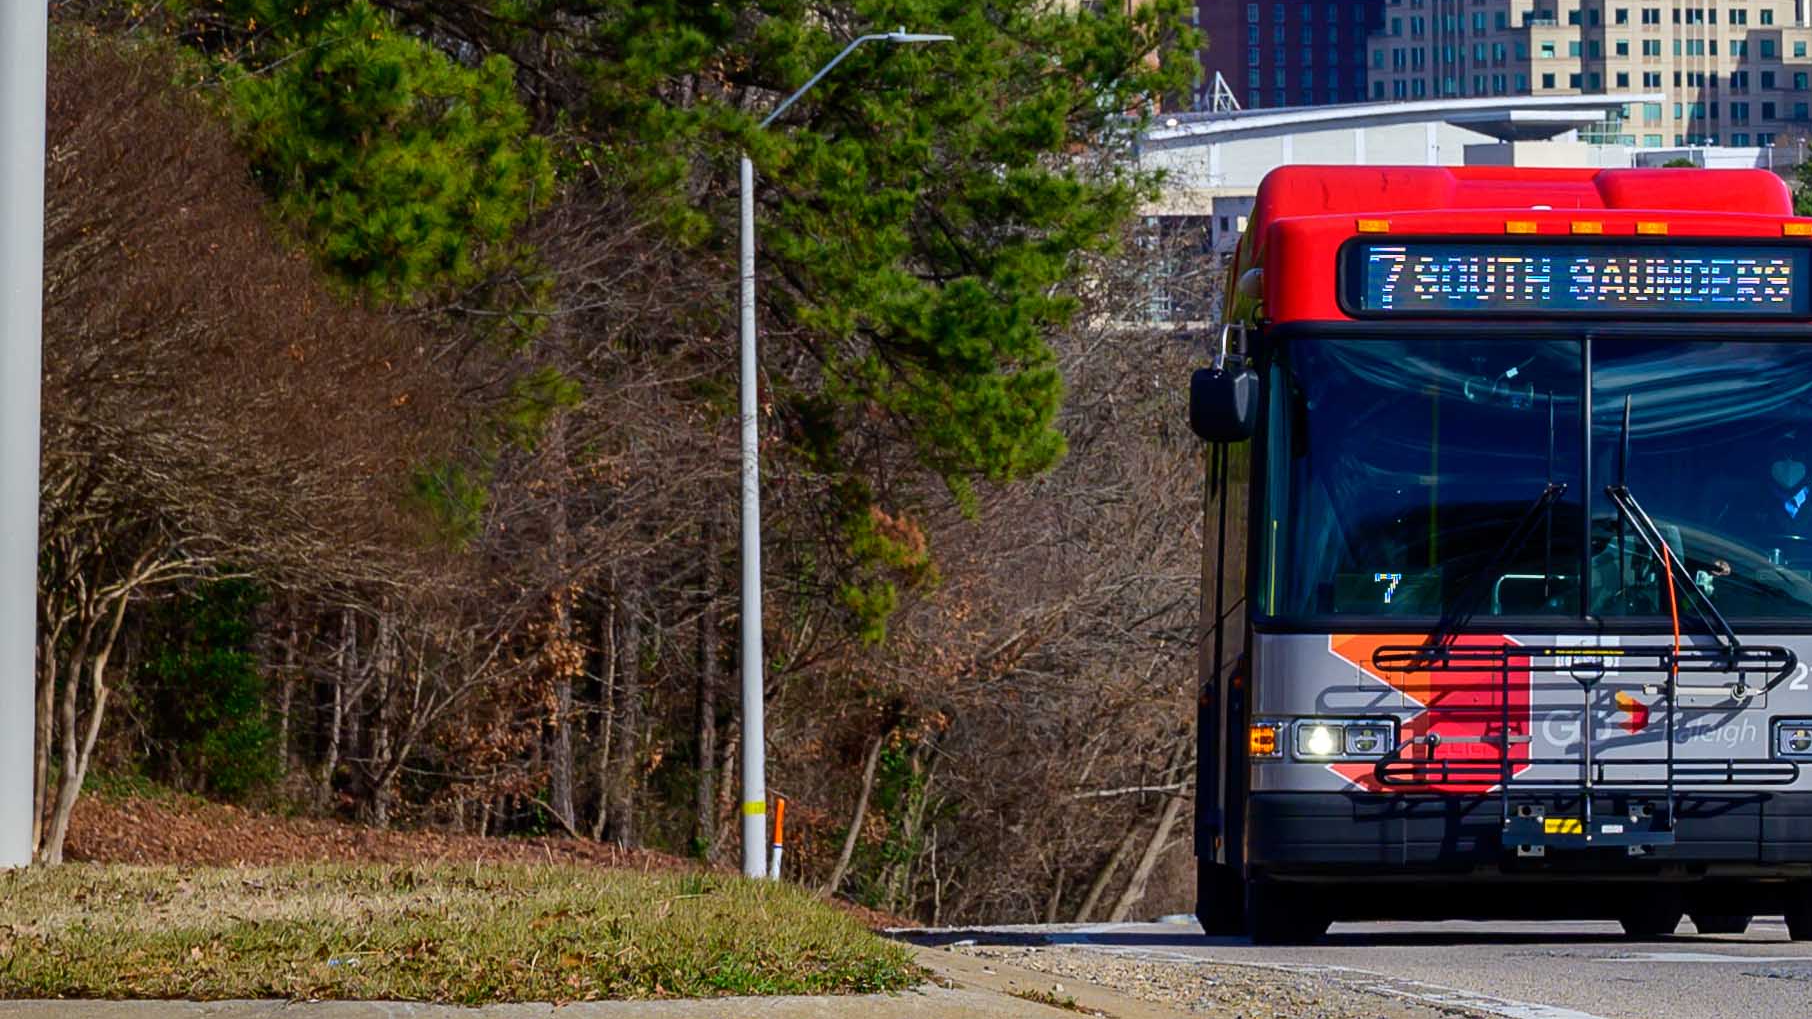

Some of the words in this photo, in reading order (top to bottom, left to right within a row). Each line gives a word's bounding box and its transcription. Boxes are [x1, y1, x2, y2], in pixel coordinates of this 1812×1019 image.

[1369, 247, 1406, 310] 7
[1414, 257, 1551, 300] SOUTH
[1569, 259, 1790, 302] SAUNDERS
[1374, 573, 1402, 604] 7
